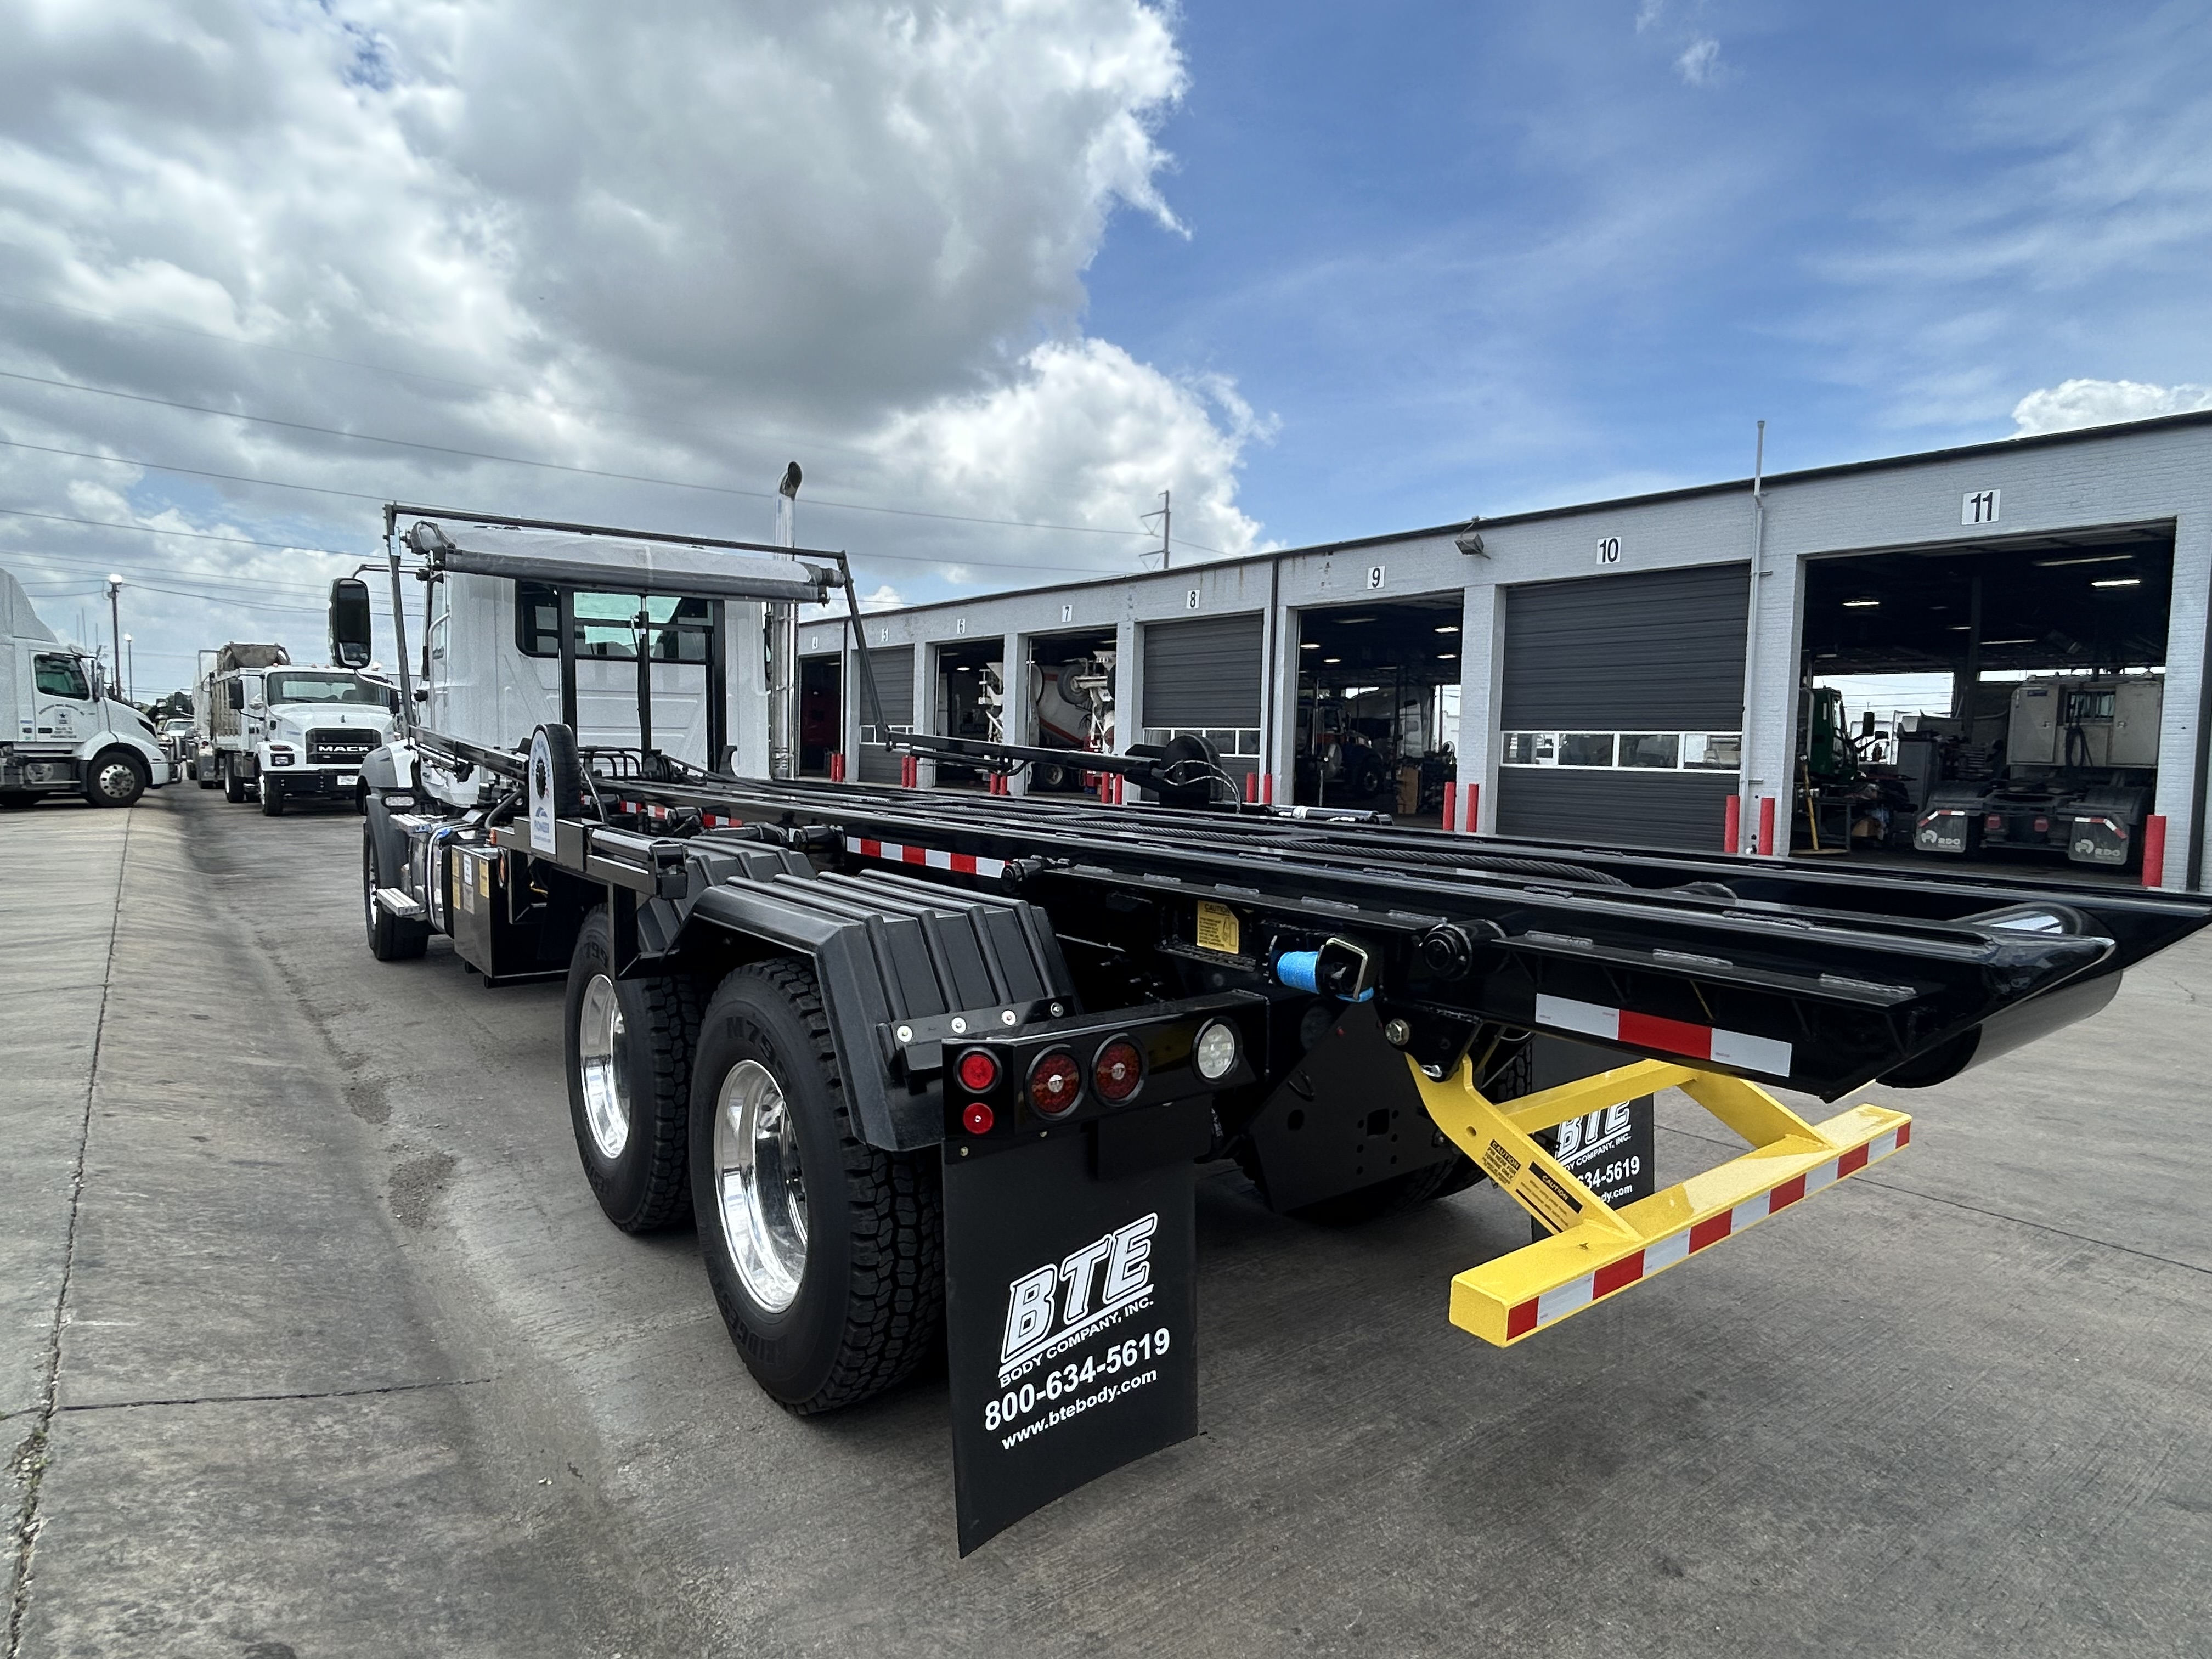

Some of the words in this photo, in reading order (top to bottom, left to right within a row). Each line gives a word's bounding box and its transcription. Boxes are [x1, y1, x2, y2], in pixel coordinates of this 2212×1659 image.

[1971, 492, 1993, 522] 11
[1600, 538, 1618, 563] 10
[1372, 567, 1380, 588] 9
[1190, 591, 1196, 608] 8
[1065, 606, 1070, 621] 7
[882, 629, 887, 642] 5
[958, 620, 963, 634] 6
[813, 639, 817, 648] 4
[579, 941, 608, 969] 799
[726, 1016, 791, 1094] M799
[1492, 1141, 1519, 1169] CAUTION
[1576, 1142, 1615, 1166] COMPANY,
[1615, 1133, 1632, 1146] INC.
[1542, 1175, 1569, 1200] CAUTION
[1599, 1184, 1633, 1203] dy.com
[1001, 1212, 1158, 1364] BTE
[1000, 1354, 1043, 1389] BODY
[1046, 1312, 1122, 1360] COMPANY,
[1125, 1299, 1154, 1318] INC.
[984, 1328, 1171, 1431] 800-634-5619
[1001, 1368, 1158, 1450] www.btebody.com
